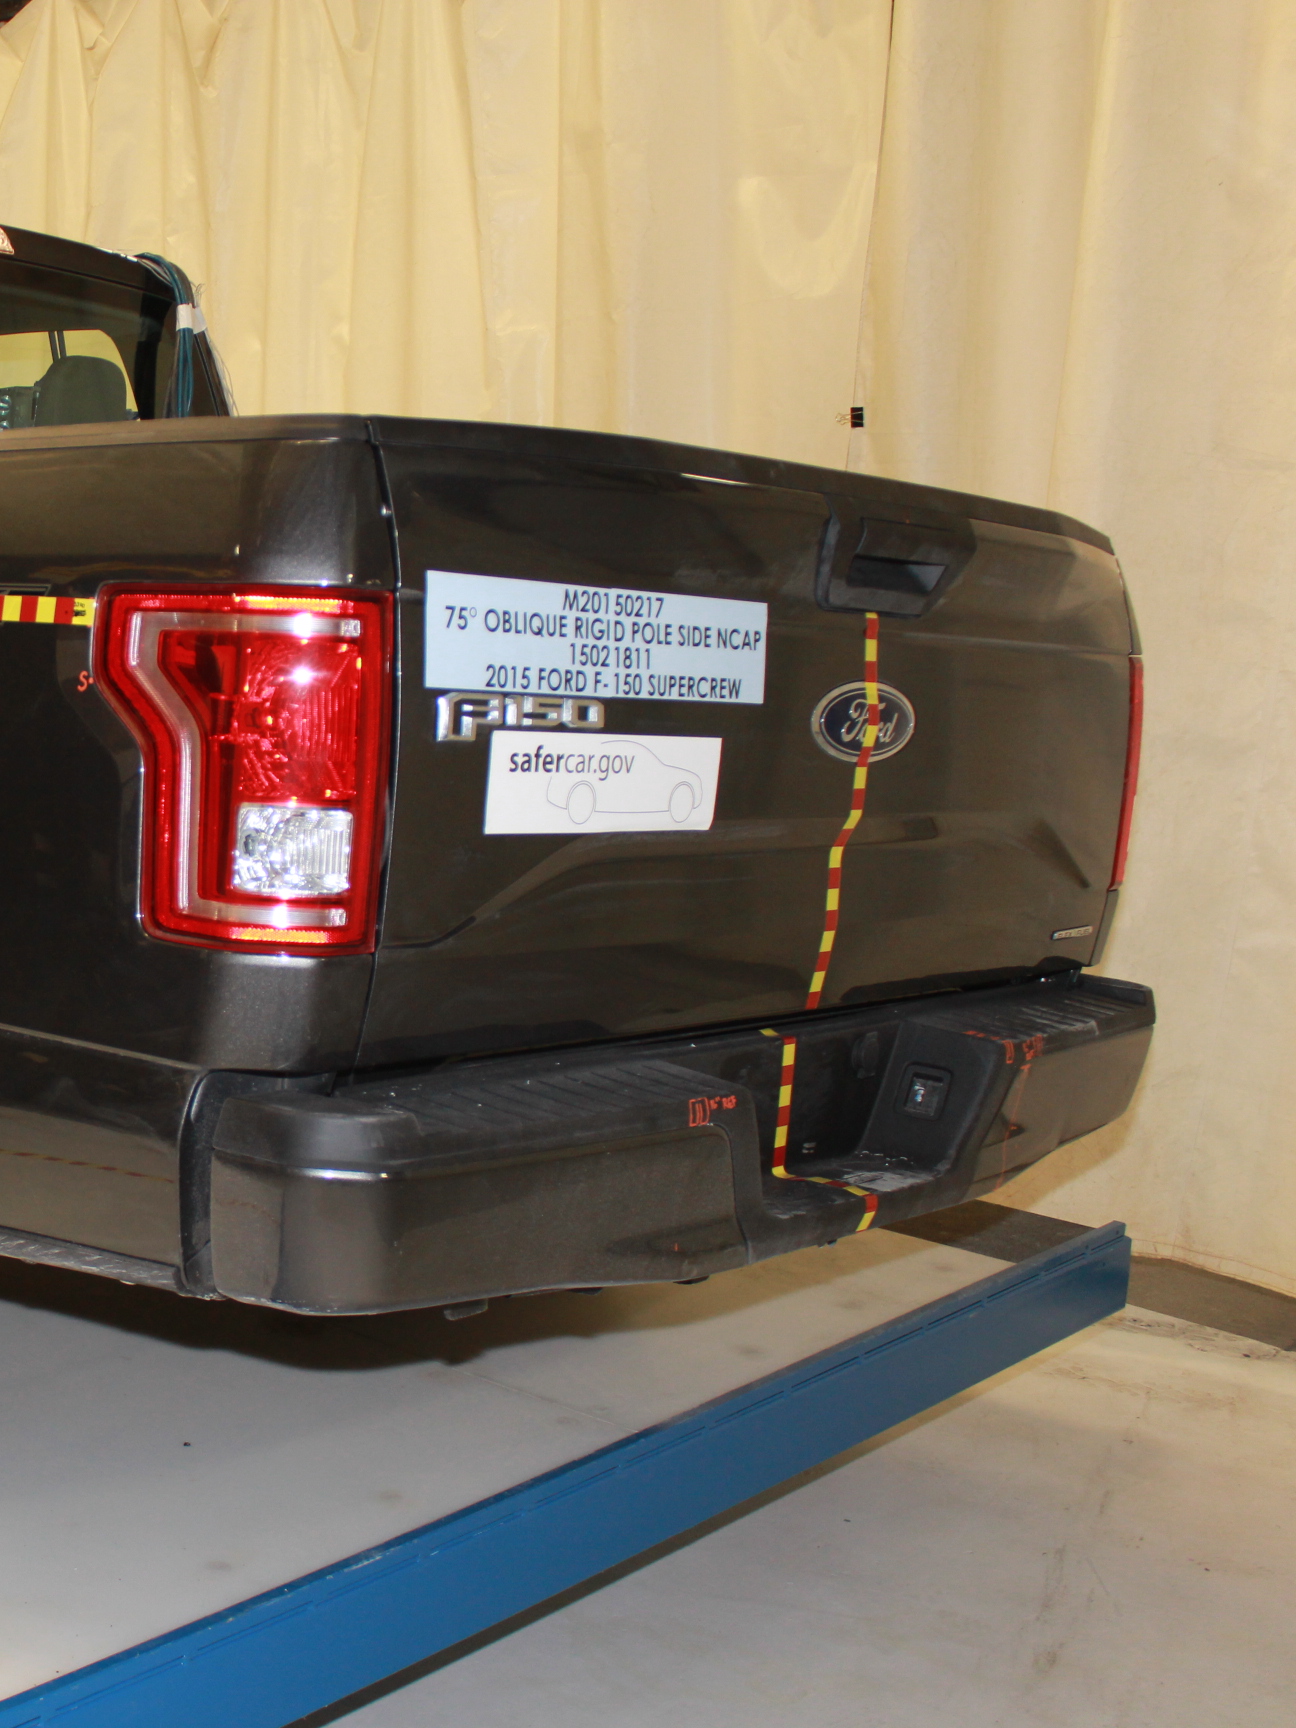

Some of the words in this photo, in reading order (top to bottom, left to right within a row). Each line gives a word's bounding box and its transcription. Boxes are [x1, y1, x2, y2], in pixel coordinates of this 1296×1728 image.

[563, 588, 664, 618] M20150217
[445, 605, 477, 630] 75°
[484, 609, 568, 639] OBLIQUE
[574, 617, 626, 643] RIGID
[631, 621, 672, 646] POLE
[678, 625, 712, 649] SIDE
[717, 628, 761, 651] NCAP
[569, 643, 652, 670] 15021811
[485, 664, 531, 690] 2015
[538, 669, 587, 693] FORD
[593, 671, 643, 696] F-150
[648, 674, 742, 700] SUPERCREW
[509, 744, 636, 782] safercar.gov
